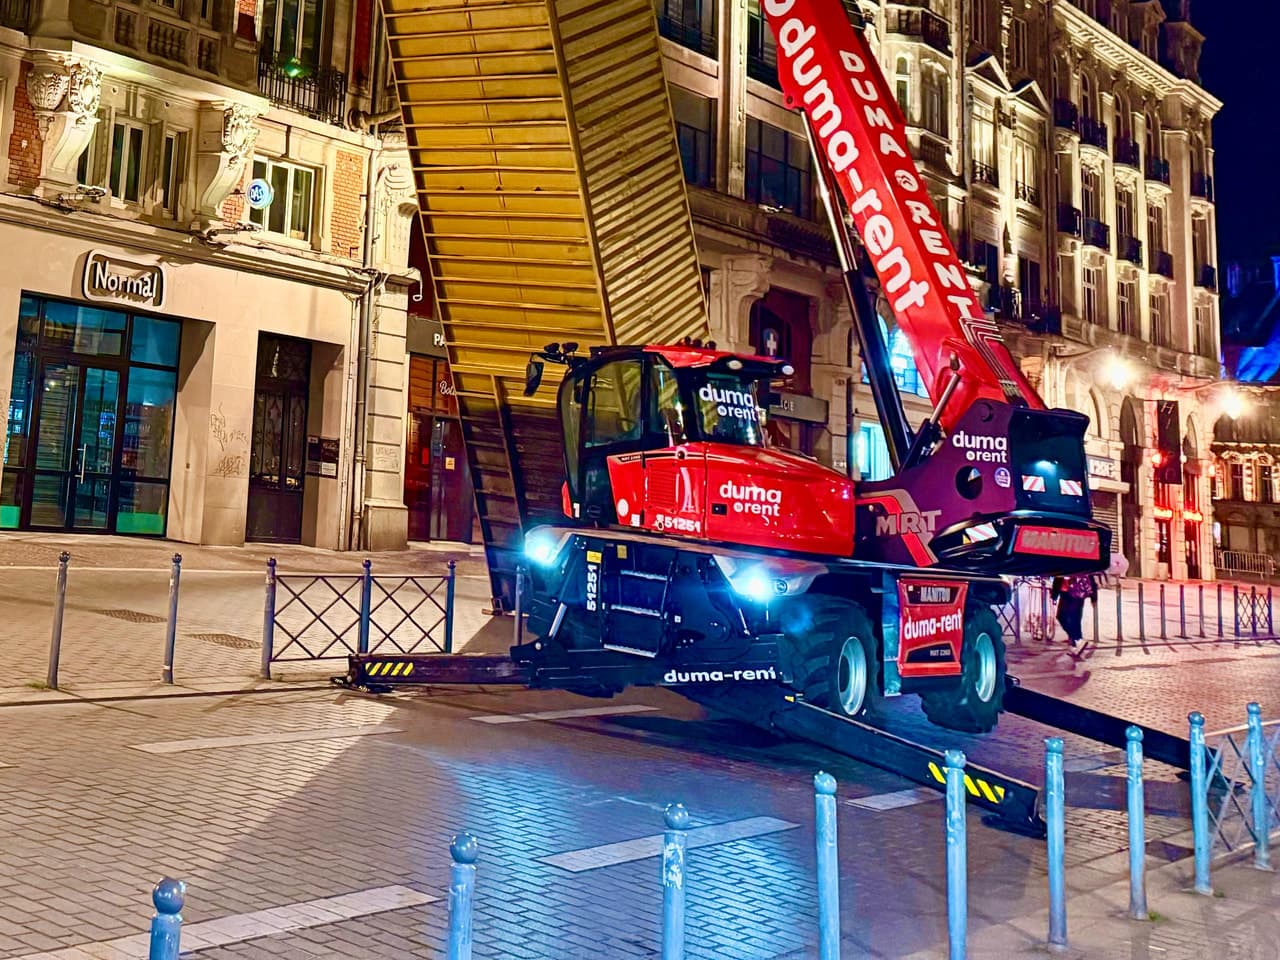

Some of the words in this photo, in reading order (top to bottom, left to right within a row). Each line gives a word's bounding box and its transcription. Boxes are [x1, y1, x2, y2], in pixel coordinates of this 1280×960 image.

[778, 17, 931, 312] duma-rent
[839, 49, 907, 159] DUMA
[904, 198, 975, 323] RENT
[92, 260, 158, 298] Normal
[699, 383, 754, 407] duma
[728, 406, 757, 422] rent
[952, 431, 1007, 450] duma
[976, 450, 1007, 464] rent
[720, 480, 782, 503] duma
[744, 502, 780, 517] rent
[876, 510, 942, 537] MRT
[1022, 530, 1097, 554] MANITOU
[586, 565, 598, 612] 51251
[904, 607, 962, 640] duma-rent
